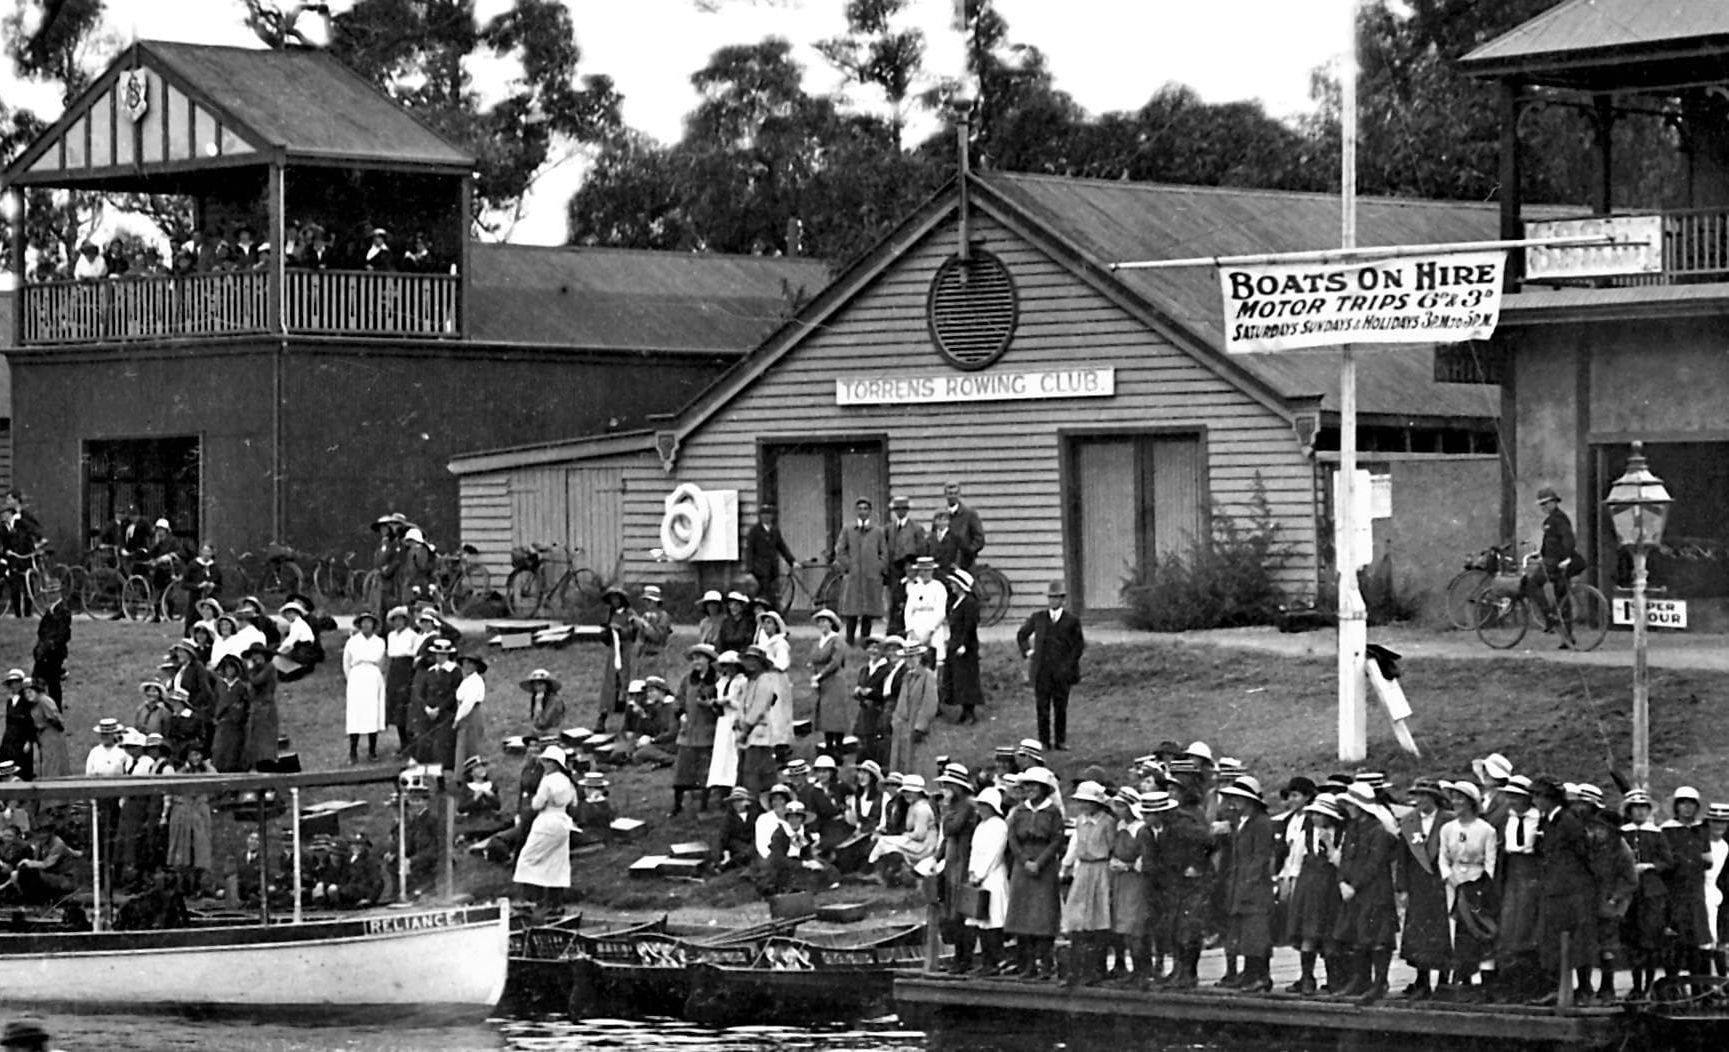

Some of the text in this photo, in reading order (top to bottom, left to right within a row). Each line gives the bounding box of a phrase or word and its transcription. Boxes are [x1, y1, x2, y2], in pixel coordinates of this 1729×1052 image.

[1228, 261, 1496, 301] BOATS ON HIRE
[1235, 297, 1327, 320] MOTOR
[1335, 292, 1410, 313] TRIPS
[1232, 322, 1299, 342] SATURDAYS
[1300, 318, 1353, 335] SUNDAYS
[1361, 314, 1420, 331] HOLIDAYS
[843, 379, 935, 401] TORRENS
[946, 375, 1027, 396] ROWING
[1645, 601, 1675, 611] PER
[1645, 612, 1682, 624] OUR
